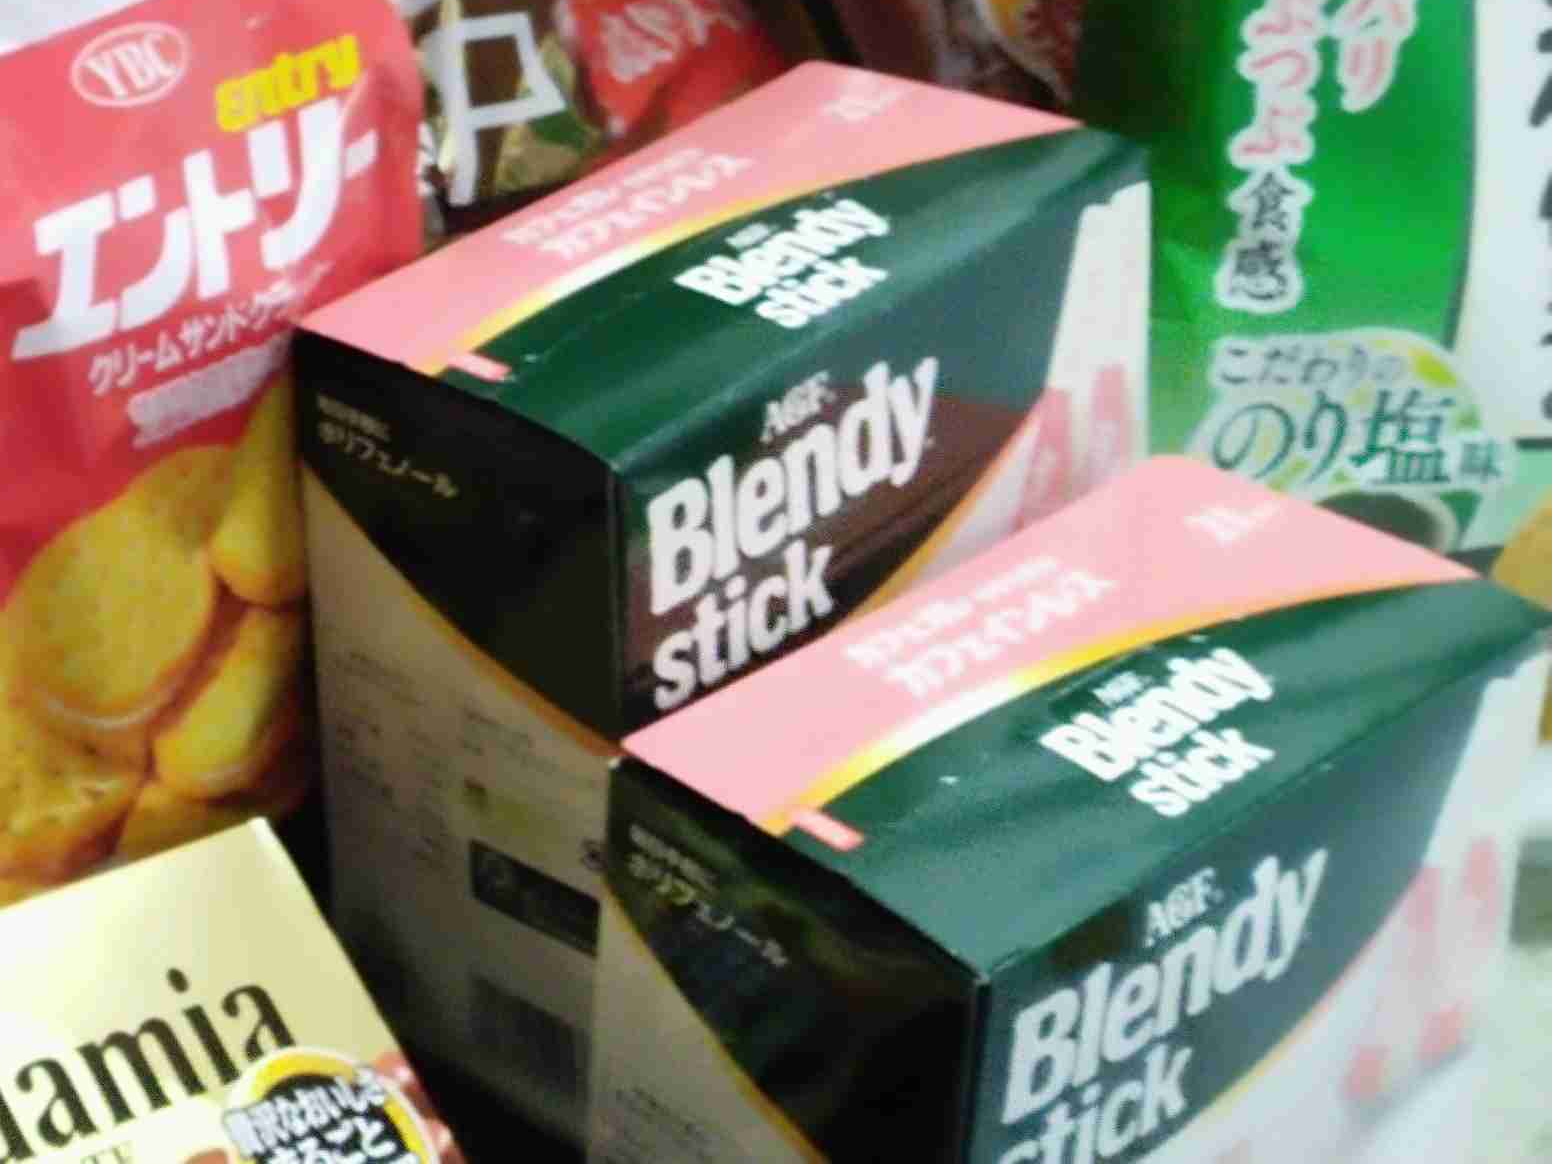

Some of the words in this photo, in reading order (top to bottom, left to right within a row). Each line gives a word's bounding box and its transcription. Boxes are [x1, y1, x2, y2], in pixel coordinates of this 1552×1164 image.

[84, 30, 179, 100] YBC
[214, 33, 363, 132] entry
[10, 96, 380, 362] エントリー
[673, 196, 892, 306] Blendy
[756, 254, 891, 329] stick
[646, 354, 942, 617] Blendy
[653, 539, 838, 714] stick
[1038, 646, 1274, 783] Blendy
[1128, 727, 1277, 818] stick
[1143, 866, 1224, 947] AGF
[1001, 848, 1329, 1126] Blendy
